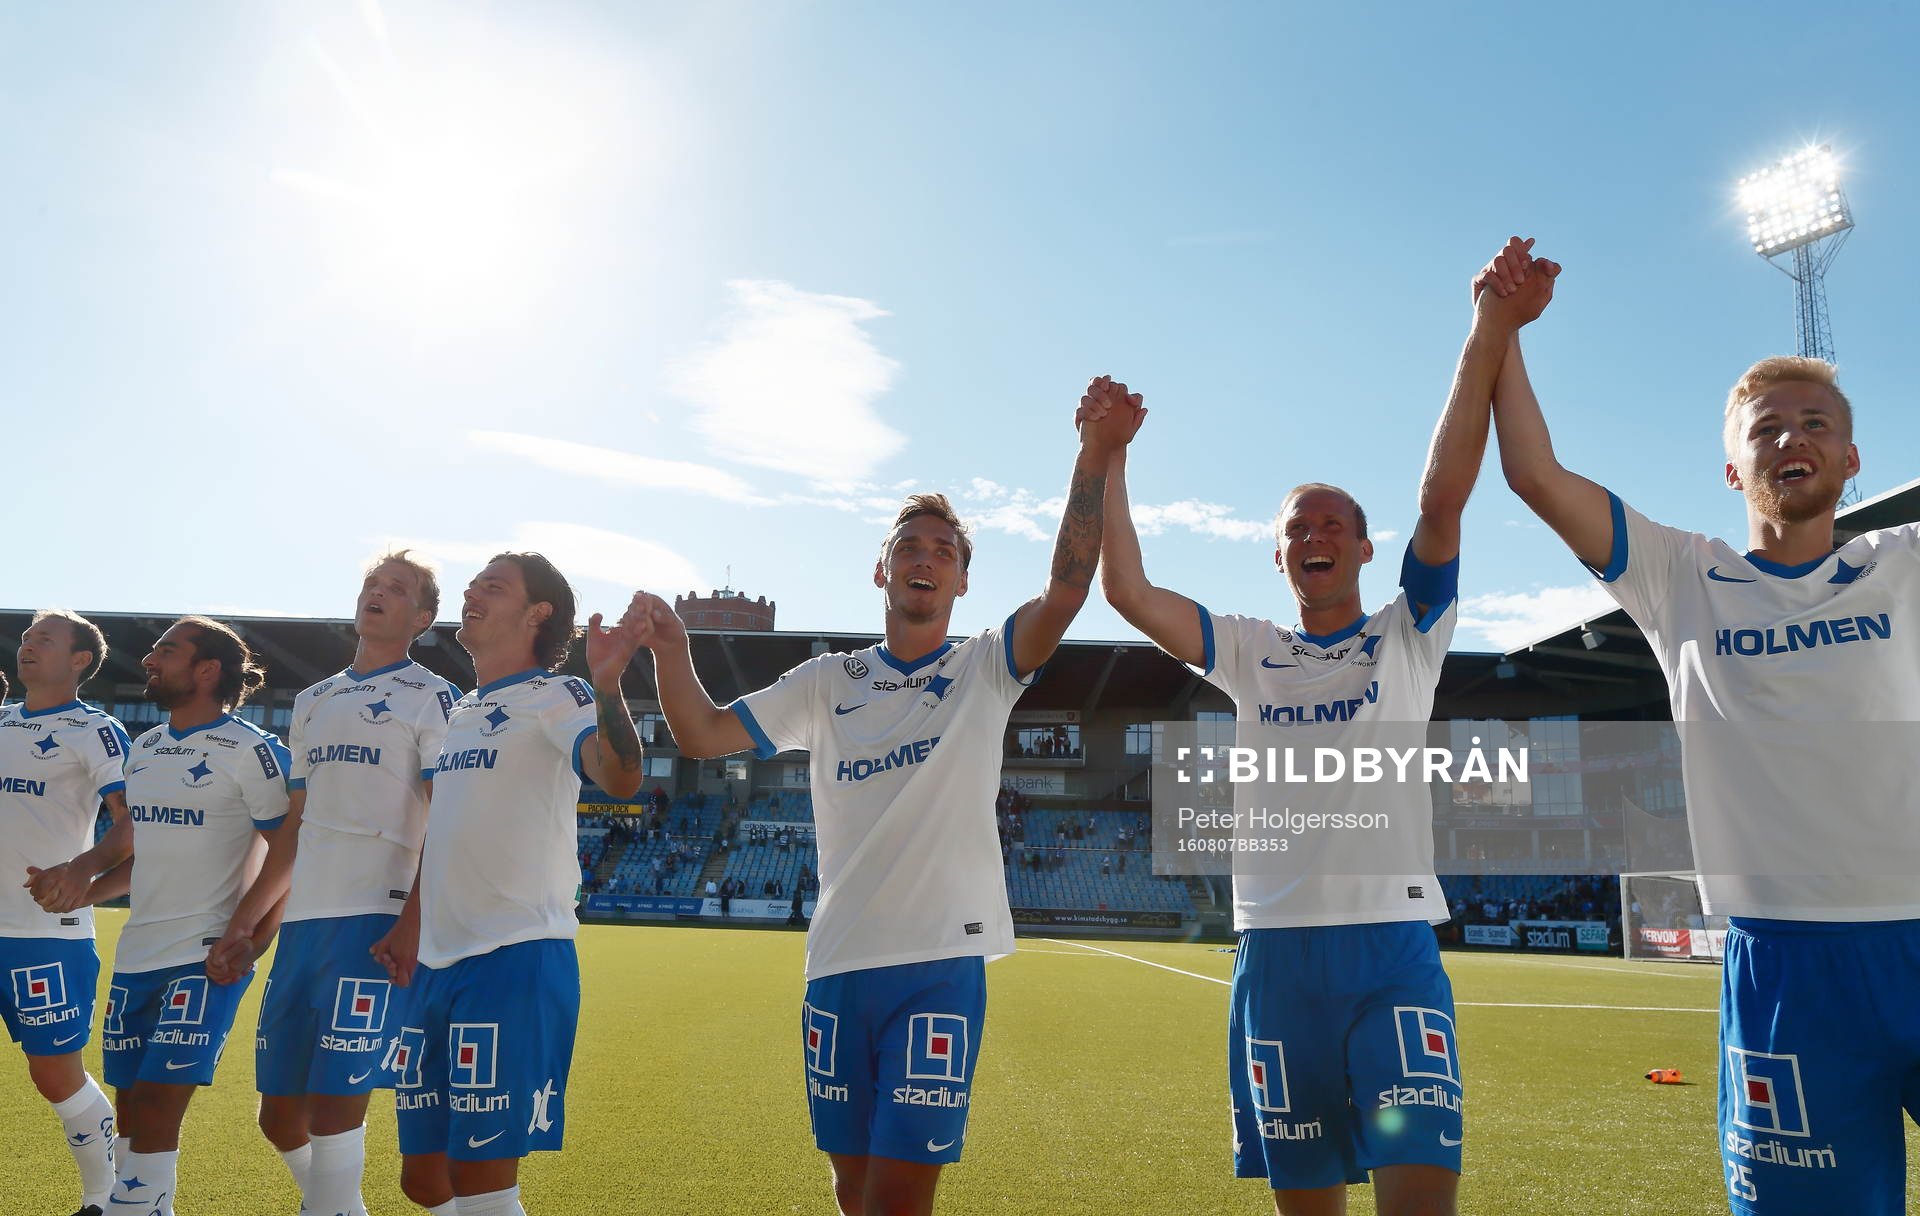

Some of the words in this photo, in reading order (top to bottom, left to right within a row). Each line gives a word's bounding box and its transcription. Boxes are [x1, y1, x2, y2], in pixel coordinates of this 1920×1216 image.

[1715, 613, 1892, 656] HOLMEN
[154, 745, 196, 756] stadium
[308, 744, 380, 767] OLMEN
[836, 736, 942, 781] HOLME
[0, 777, 46, 797] MEN
[130, 806, 204, 826] OLMEN
[320, 1034, 382, 1052] stadium
[396, 1090, 440, 1110] dium
[893, 1084, 967, 1108] stadium
[1727, 1130, 1837, 1169] stadium
[1728, 1159, 1757, 1201] 25
